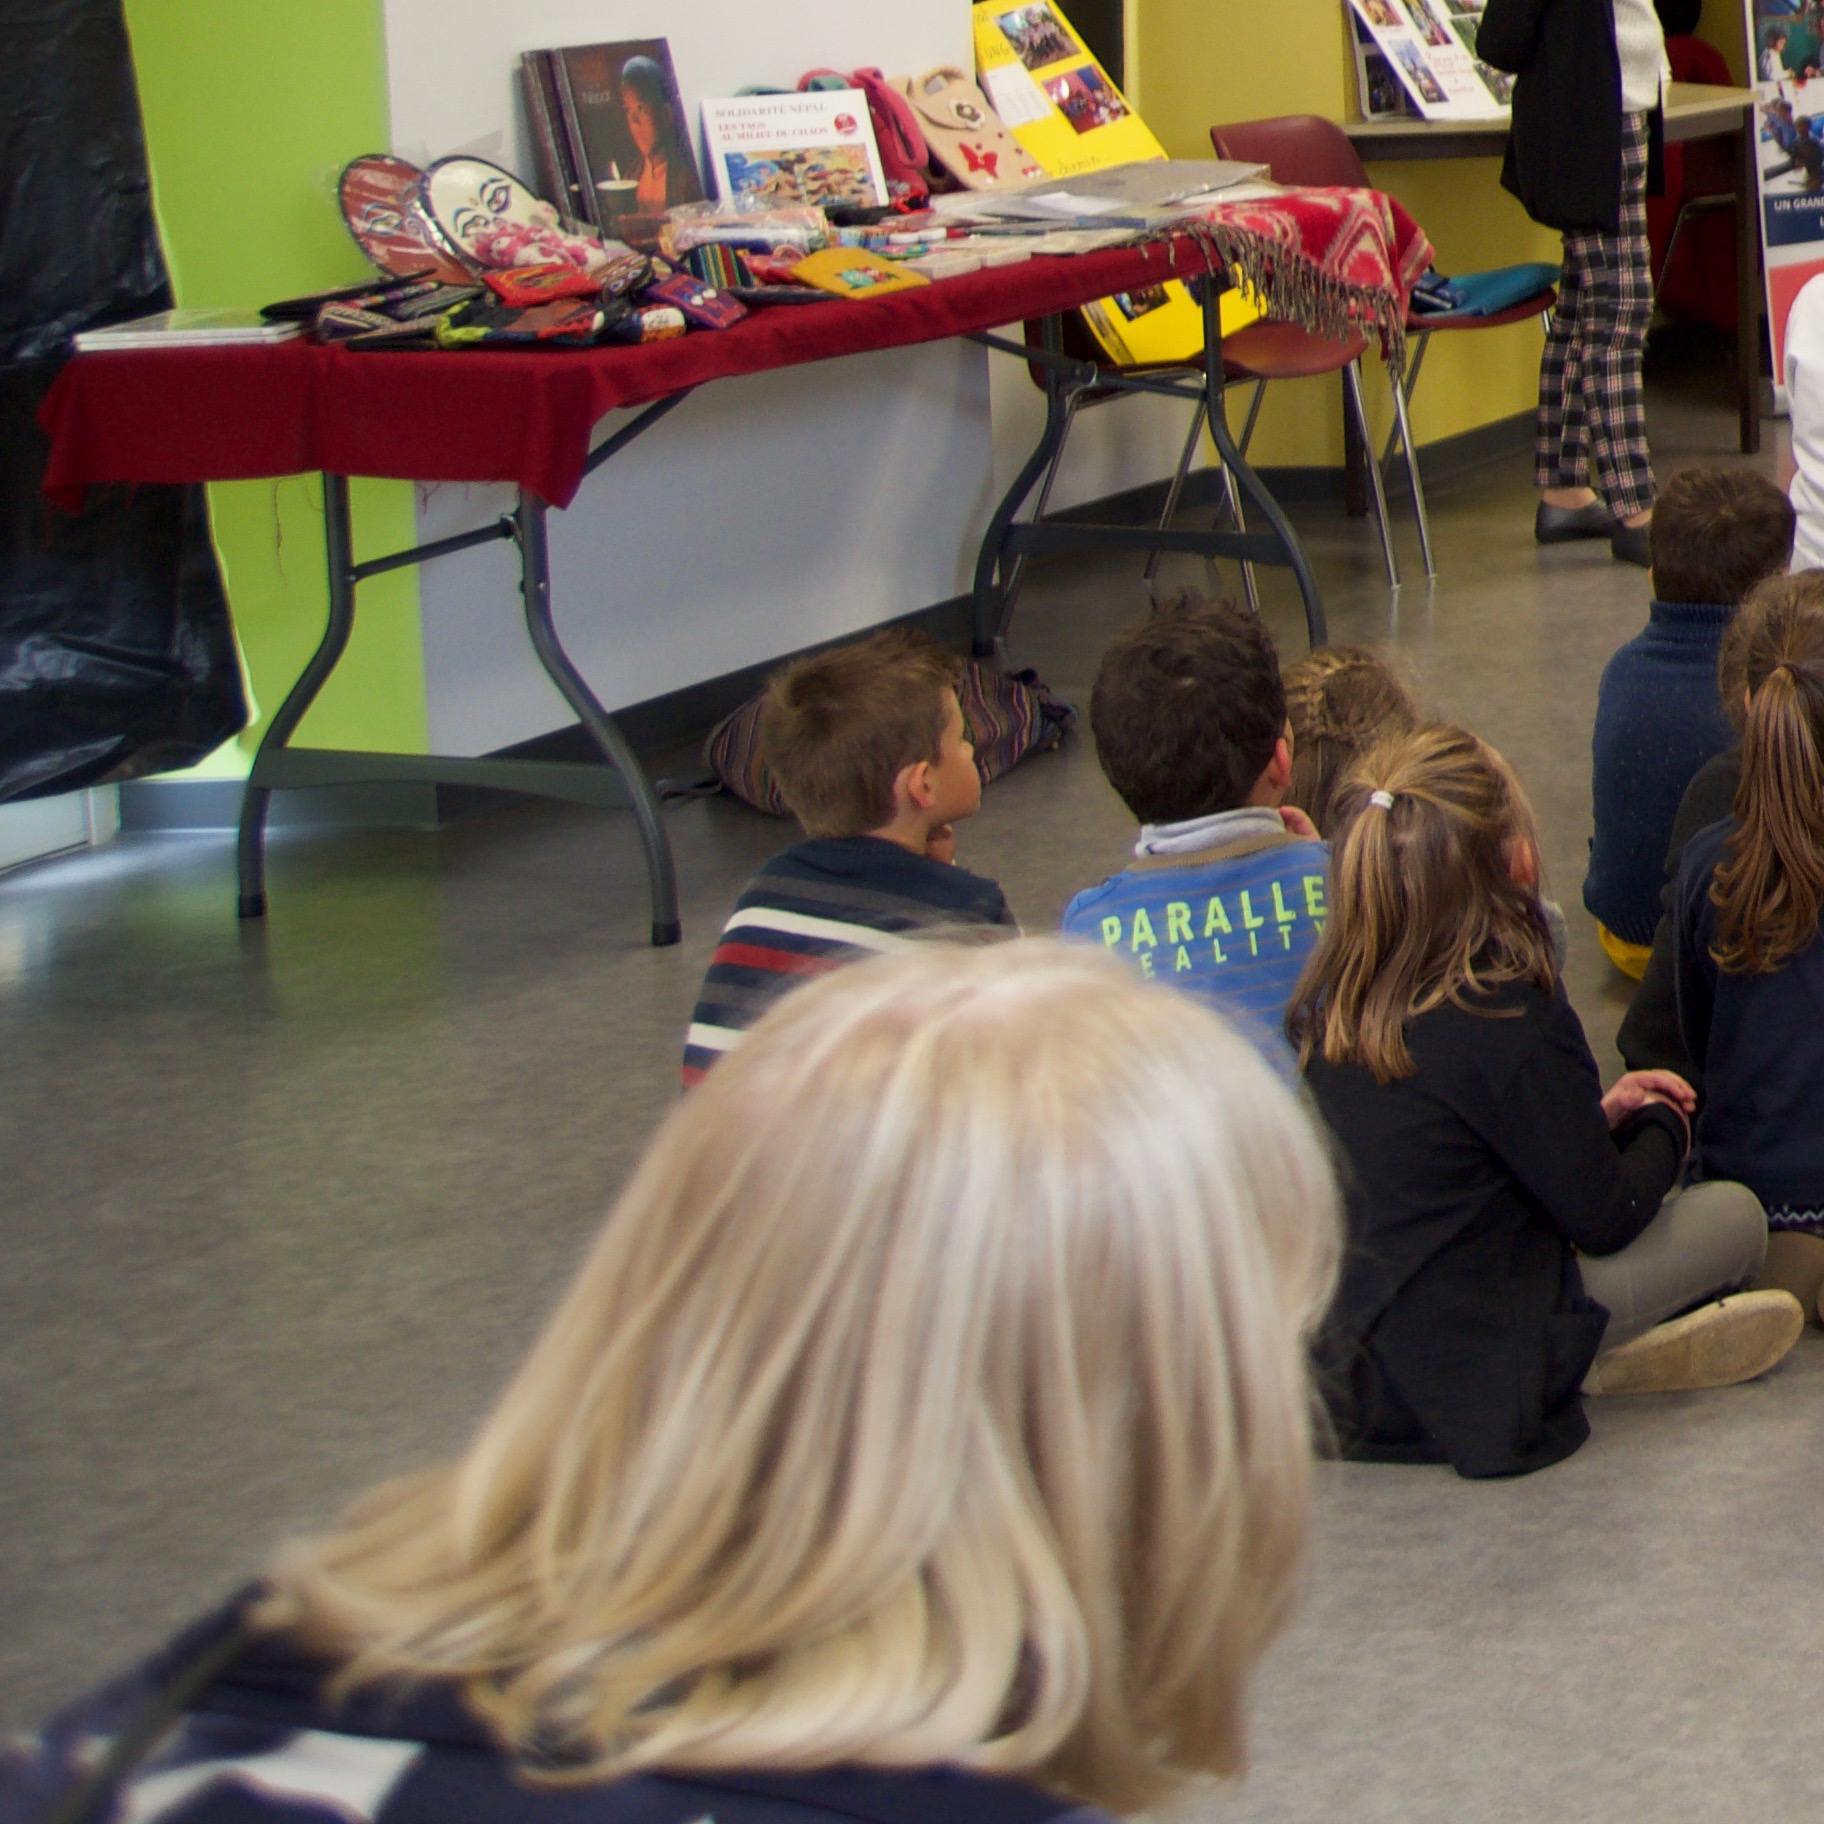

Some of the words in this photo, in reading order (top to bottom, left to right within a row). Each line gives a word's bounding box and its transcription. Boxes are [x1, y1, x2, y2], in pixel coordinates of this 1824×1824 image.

[1773, 199, 1791, 212] UN
[1101, 875, 1329, 953] PARALLE
[1140, 919, 1327, 978] EALITY
